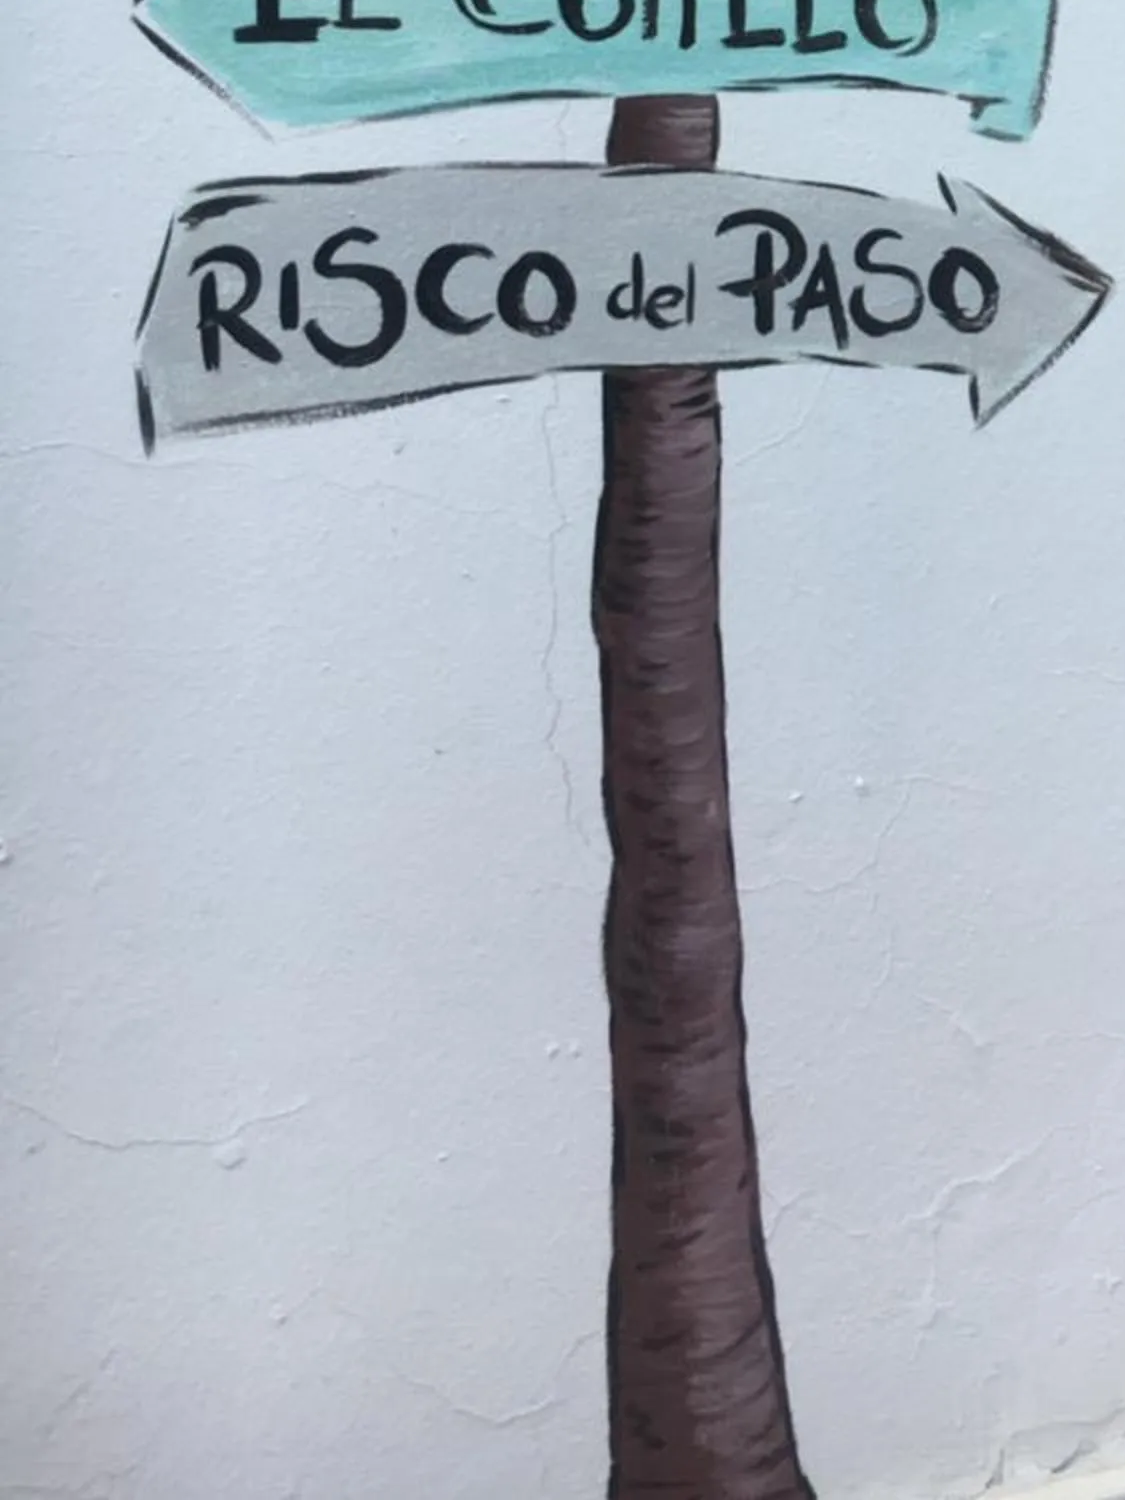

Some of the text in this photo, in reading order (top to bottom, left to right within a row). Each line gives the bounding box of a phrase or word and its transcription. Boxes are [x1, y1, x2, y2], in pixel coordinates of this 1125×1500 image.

[189, 209, 1000, 371] RISCO del PASO
